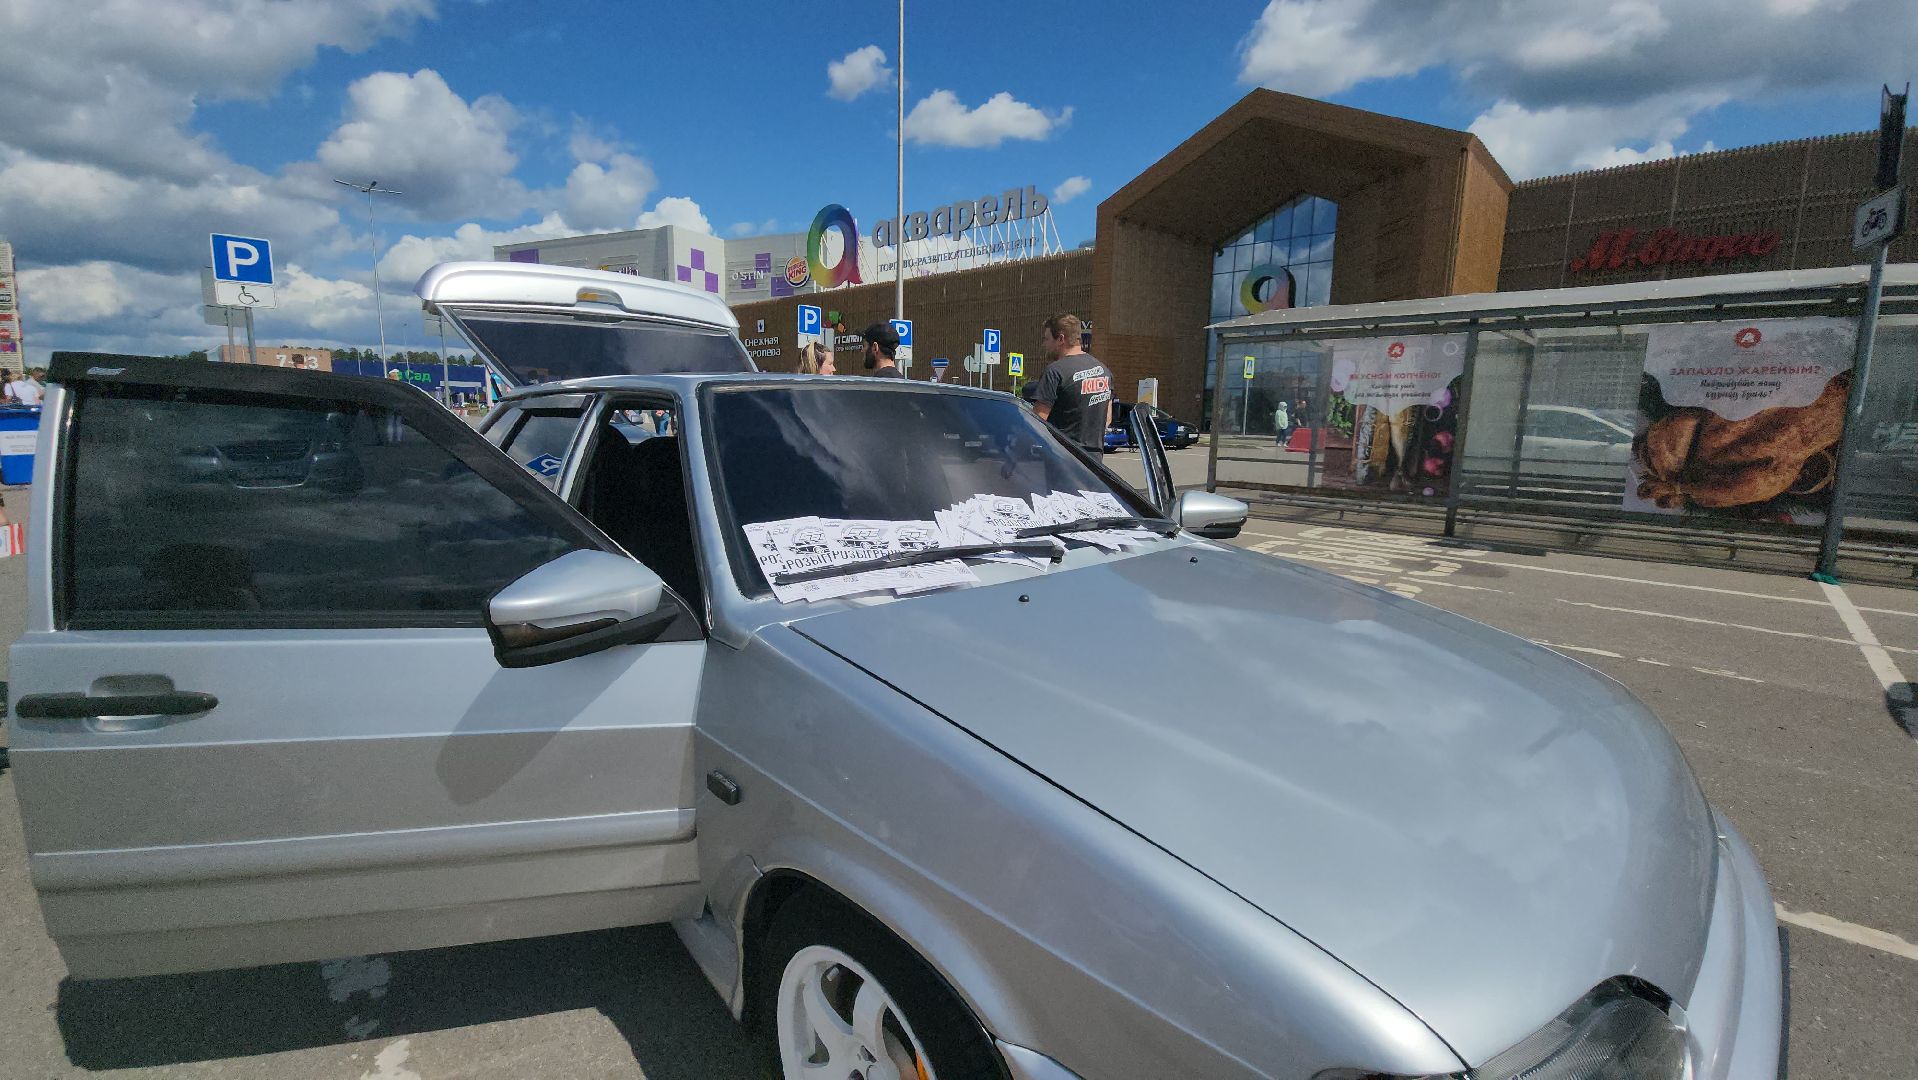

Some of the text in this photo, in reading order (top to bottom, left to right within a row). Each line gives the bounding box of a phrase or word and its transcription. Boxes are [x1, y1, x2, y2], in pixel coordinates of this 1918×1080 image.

[872, 184, 1049, 249] акварель
[226, 240, 260, 277] P
[788, 265, 807, 280] KING
[804, 308, 818, 331] P
[988, 331, 998, 350] P
